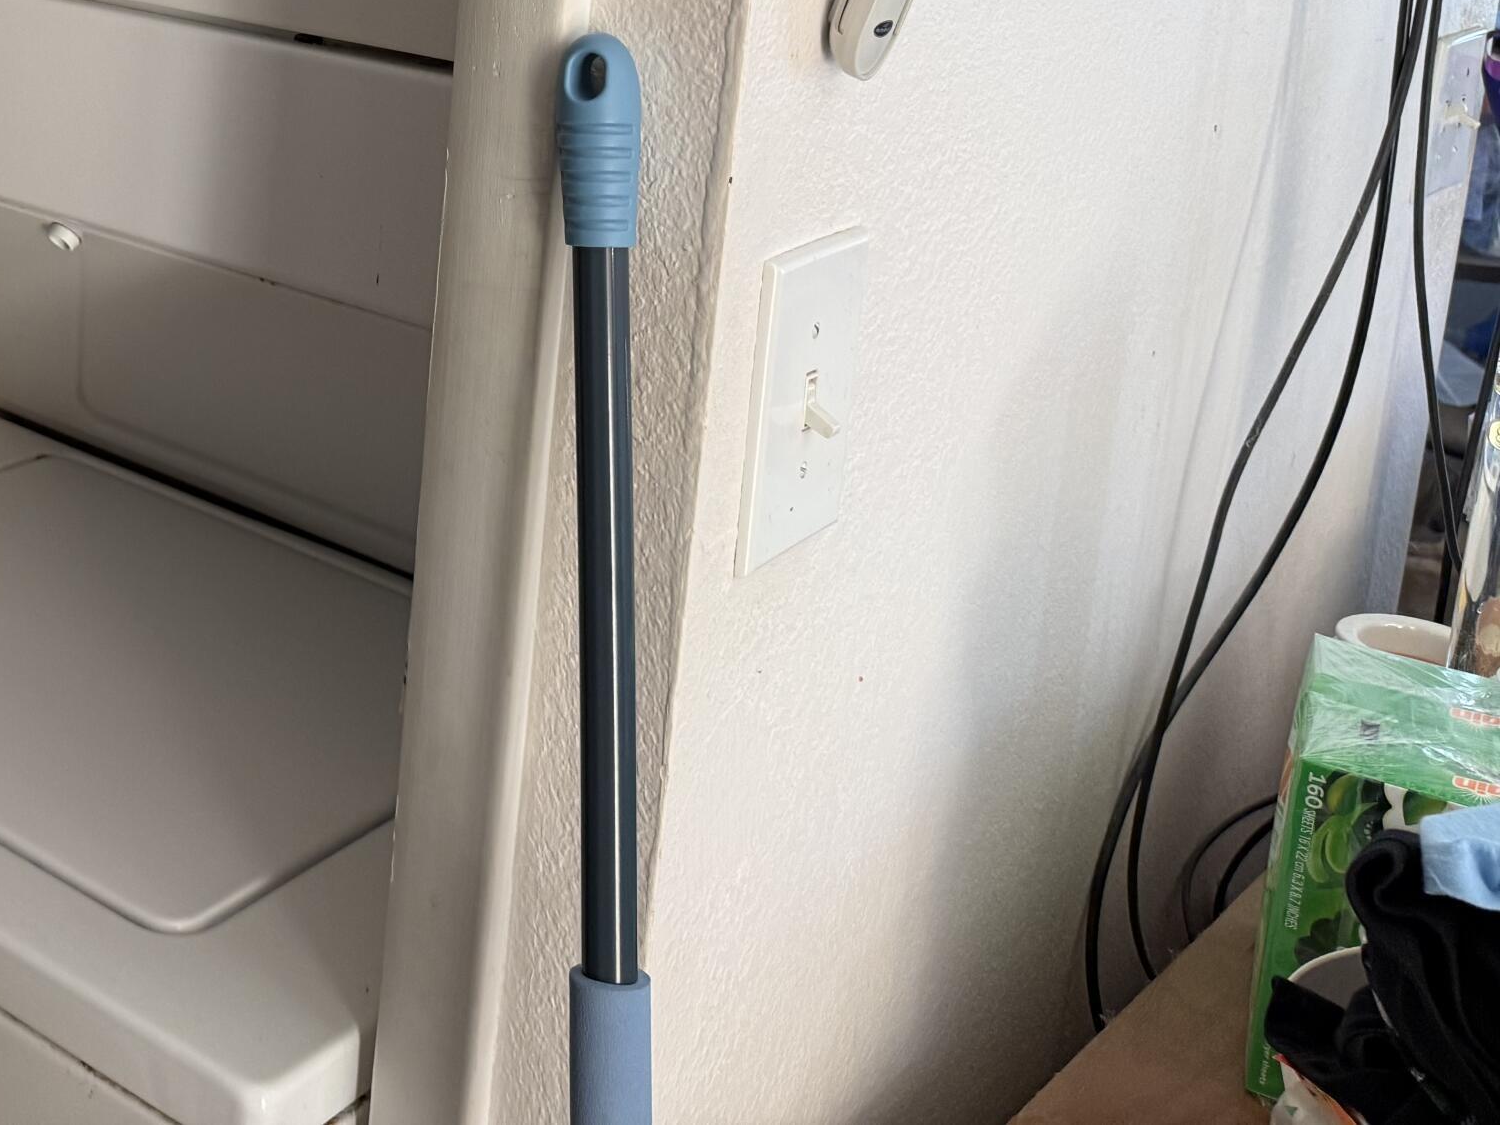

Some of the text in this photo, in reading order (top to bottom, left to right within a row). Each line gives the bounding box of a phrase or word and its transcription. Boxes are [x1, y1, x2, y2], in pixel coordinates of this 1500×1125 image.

[1305, 772, 1327, 810] 160
[1300, 808, 1316, 834] SHEETS
[1293, 862, 1303, 872] cm
[1295, 850, 1307, 862] 22
[1284, 904, 1299, 929] INCHES
